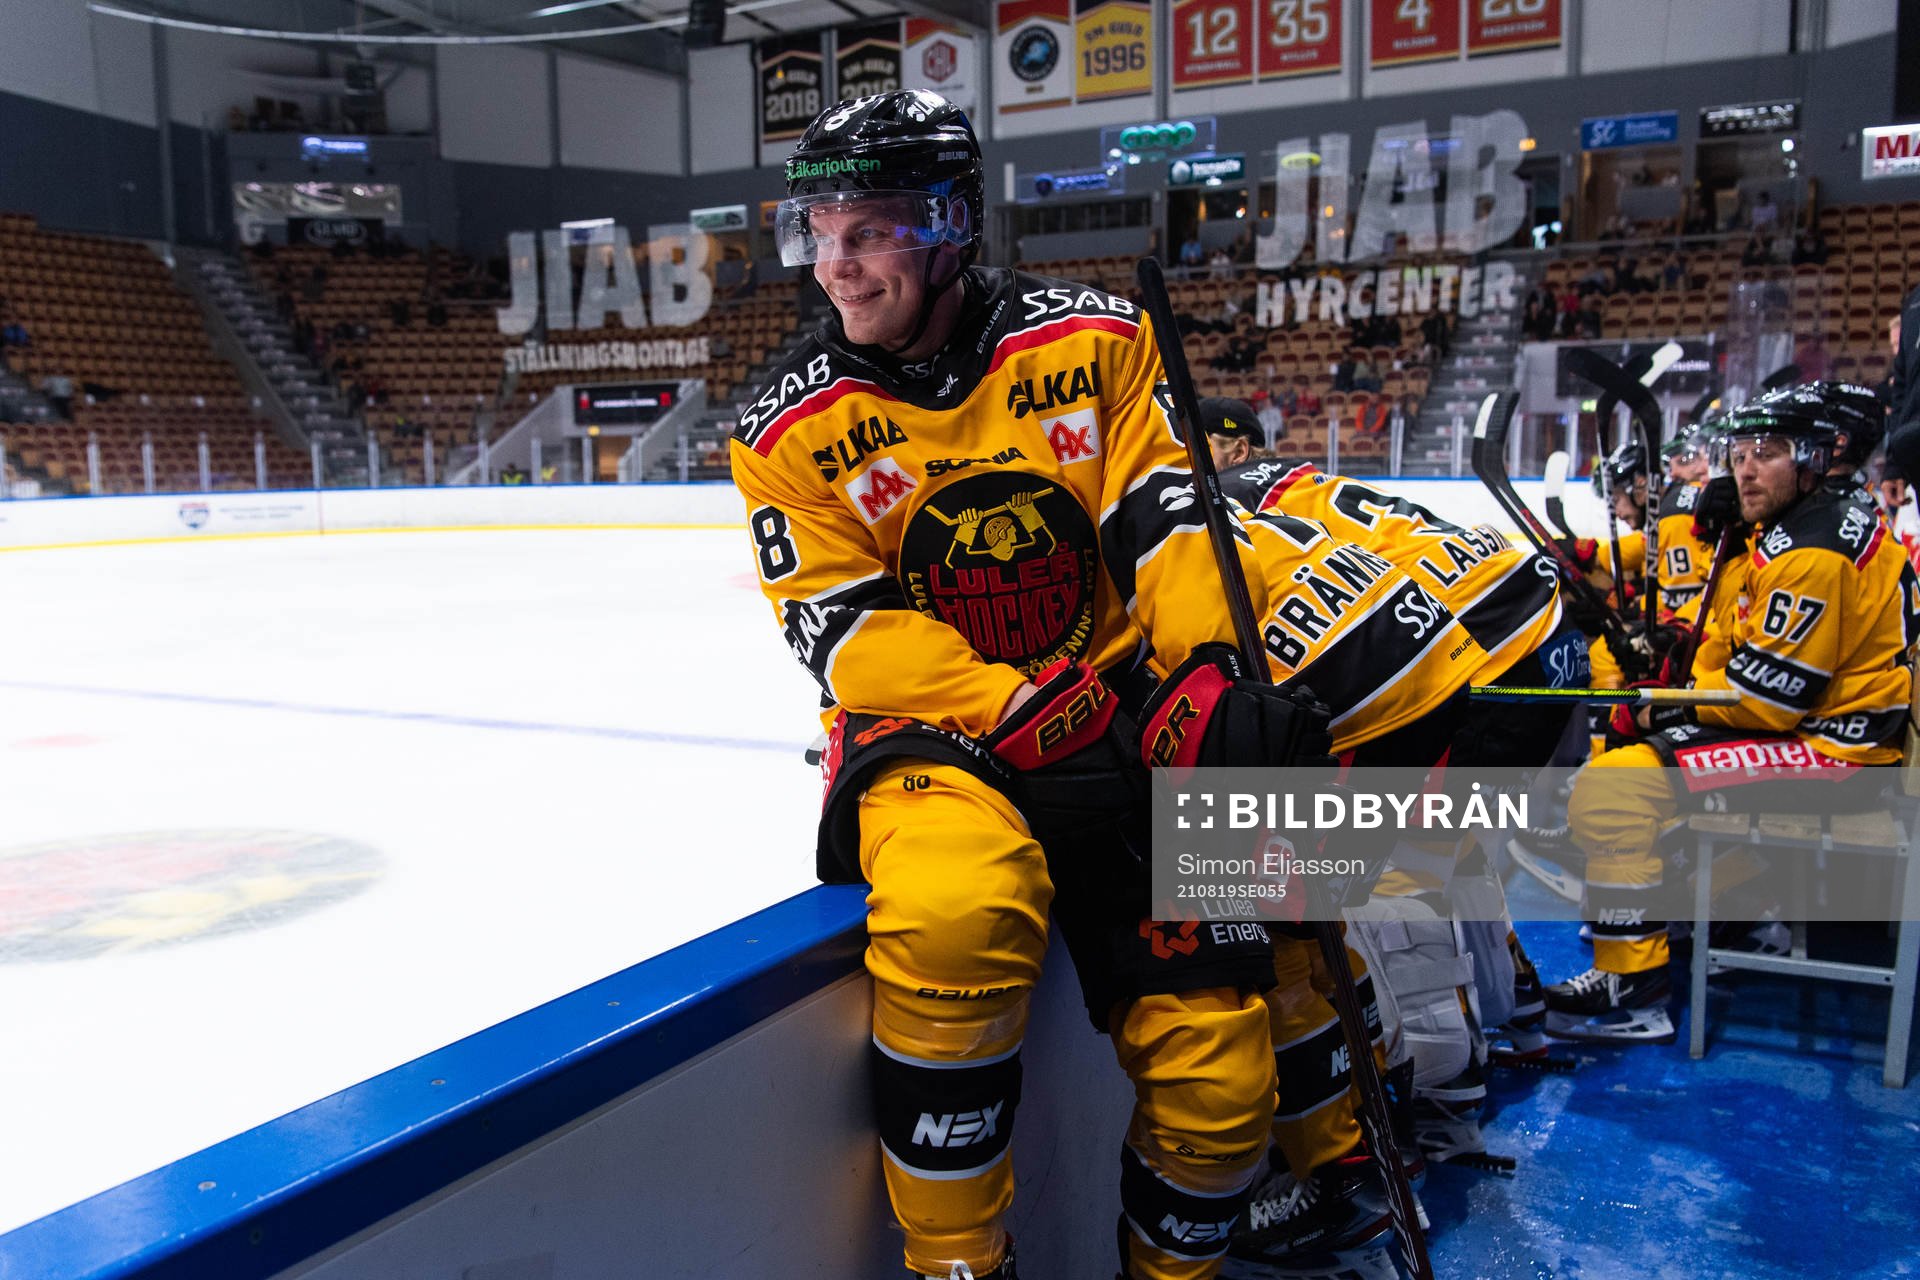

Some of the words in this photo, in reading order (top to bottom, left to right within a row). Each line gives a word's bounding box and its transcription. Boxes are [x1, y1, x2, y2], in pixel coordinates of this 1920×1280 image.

[1188, 7, 1238, 57] 12
[1271, 0, 1329, 46] 35
[1395, 0, 1431, 31] 4
[1083, 41, 1146, 77] 1996
[766, 87, 820, 121] 2018
[787, 157, 881, 181] Läkarjouren
[1255, 109, 1528, 269] JIAB
[497, 223, 713, 335] JIAB
[1255, 261, 1518, 328] HYRCENTER
[1022, 288, 1134, 320] SSAB
[740, 353, 831, 442] SSAB
[837, 416, 908, 473] LKAB
[1048, 420, 1096, 463] AX
[857, 469, 917, 520] MAX
[1647, 471, 1662, 578] NEXUS
[930, 541, 1080, 596] LULEÅ
[1665, 547, 1692, 577] 19
[908, 571, 937, 620] LULE
[935, 579, 1081, 659] HOCKEY
[1394, 583, 1449, 640] SSA
[1763, 588, 1827, 647] 67
[1740, 658, 1807, 698] LKAB
[1210, 922, 1271, 945] Energ
[1597, 908, 1647, 926] NEX
[911, 1100, 1004, 1148] NEX
[1158, 1213, 1240, 1245] NEX
